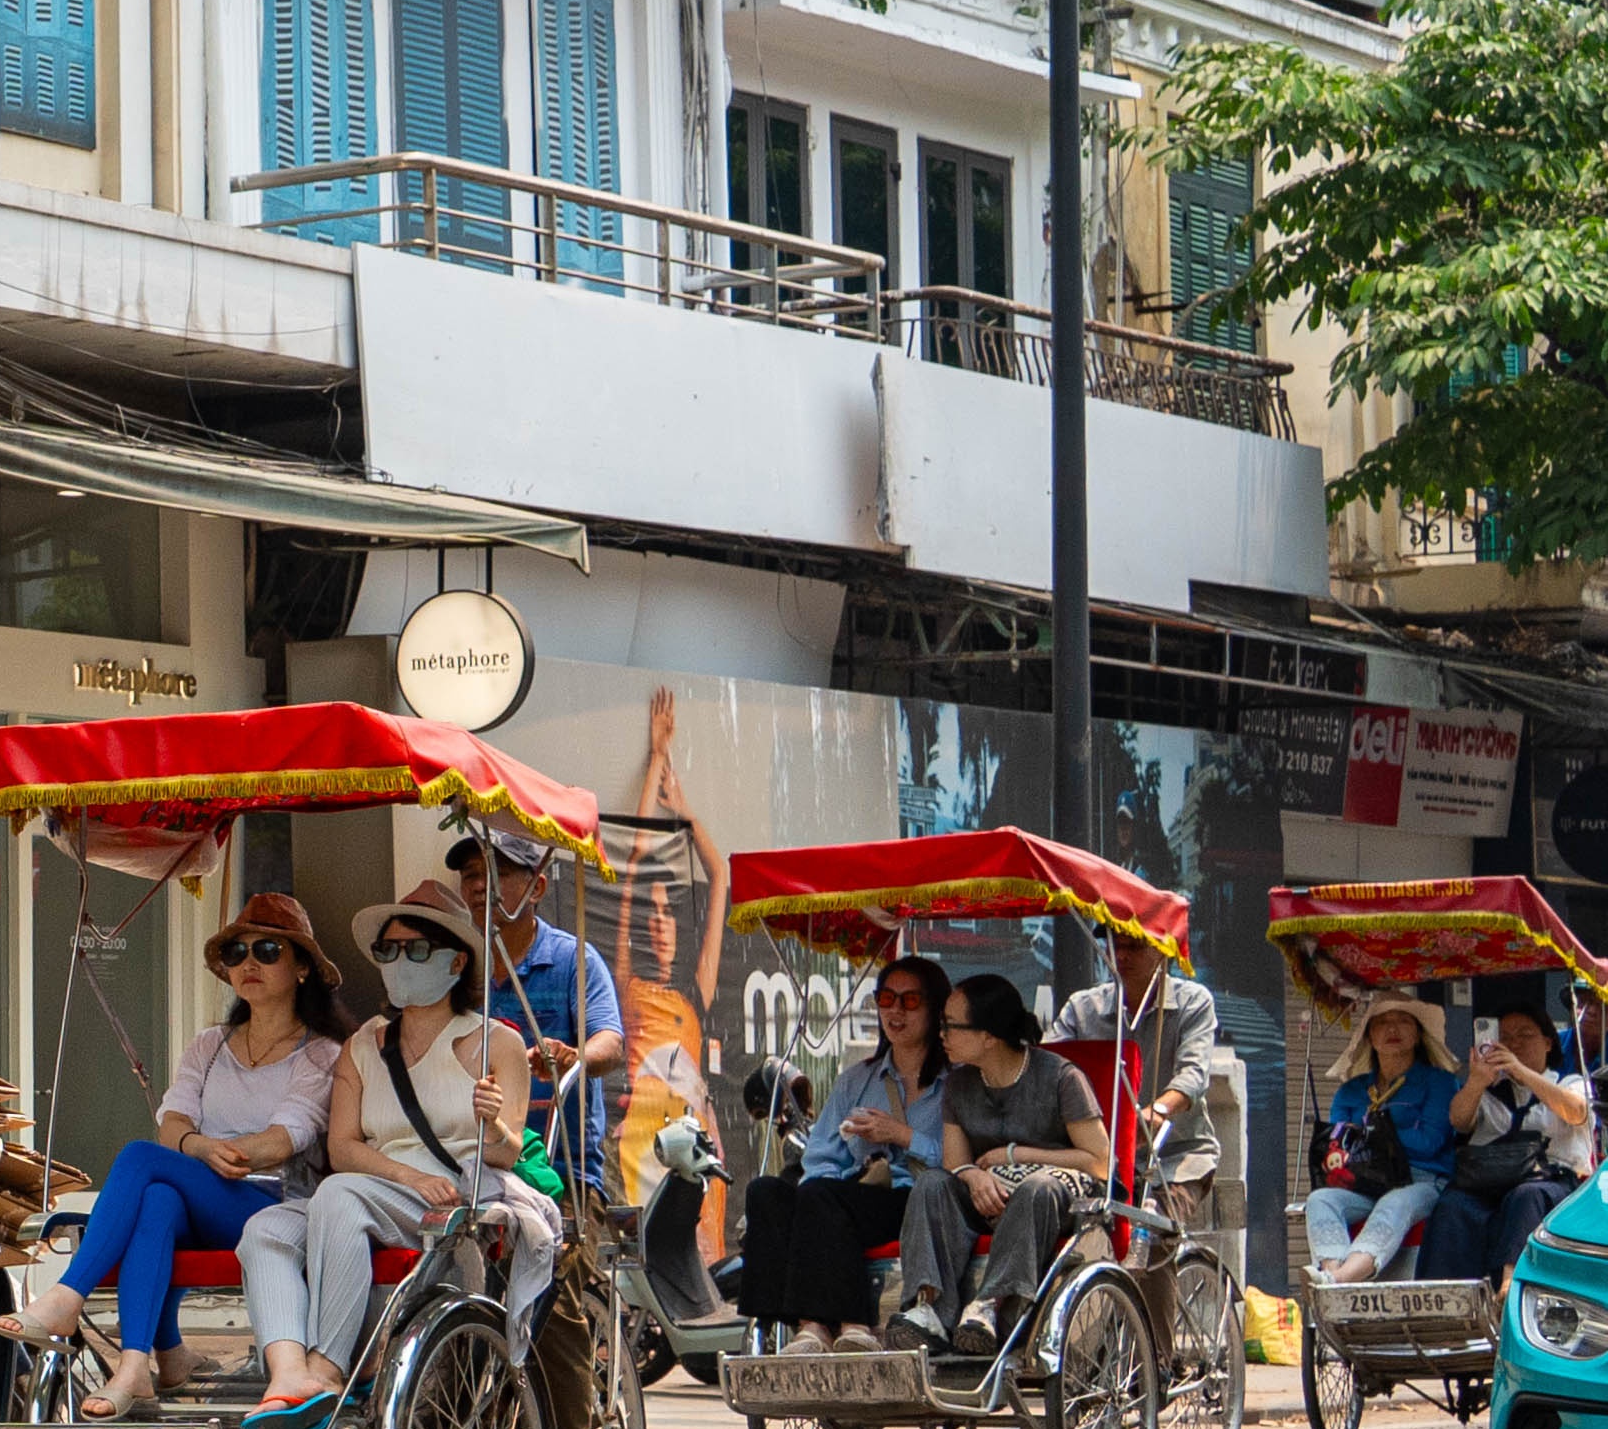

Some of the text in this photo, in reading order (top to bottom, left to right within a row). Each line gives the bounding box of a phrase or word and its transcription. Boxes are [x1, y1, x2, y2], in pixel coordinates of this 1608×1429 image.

[411, 648, 511, 675] métaphore
[73, 658, 197, 707] métaphore
[1348, 714, 1408, 766] deli
[1286, 750, 1308, 772] 210
[1310, 753, 1334, 776] 837
